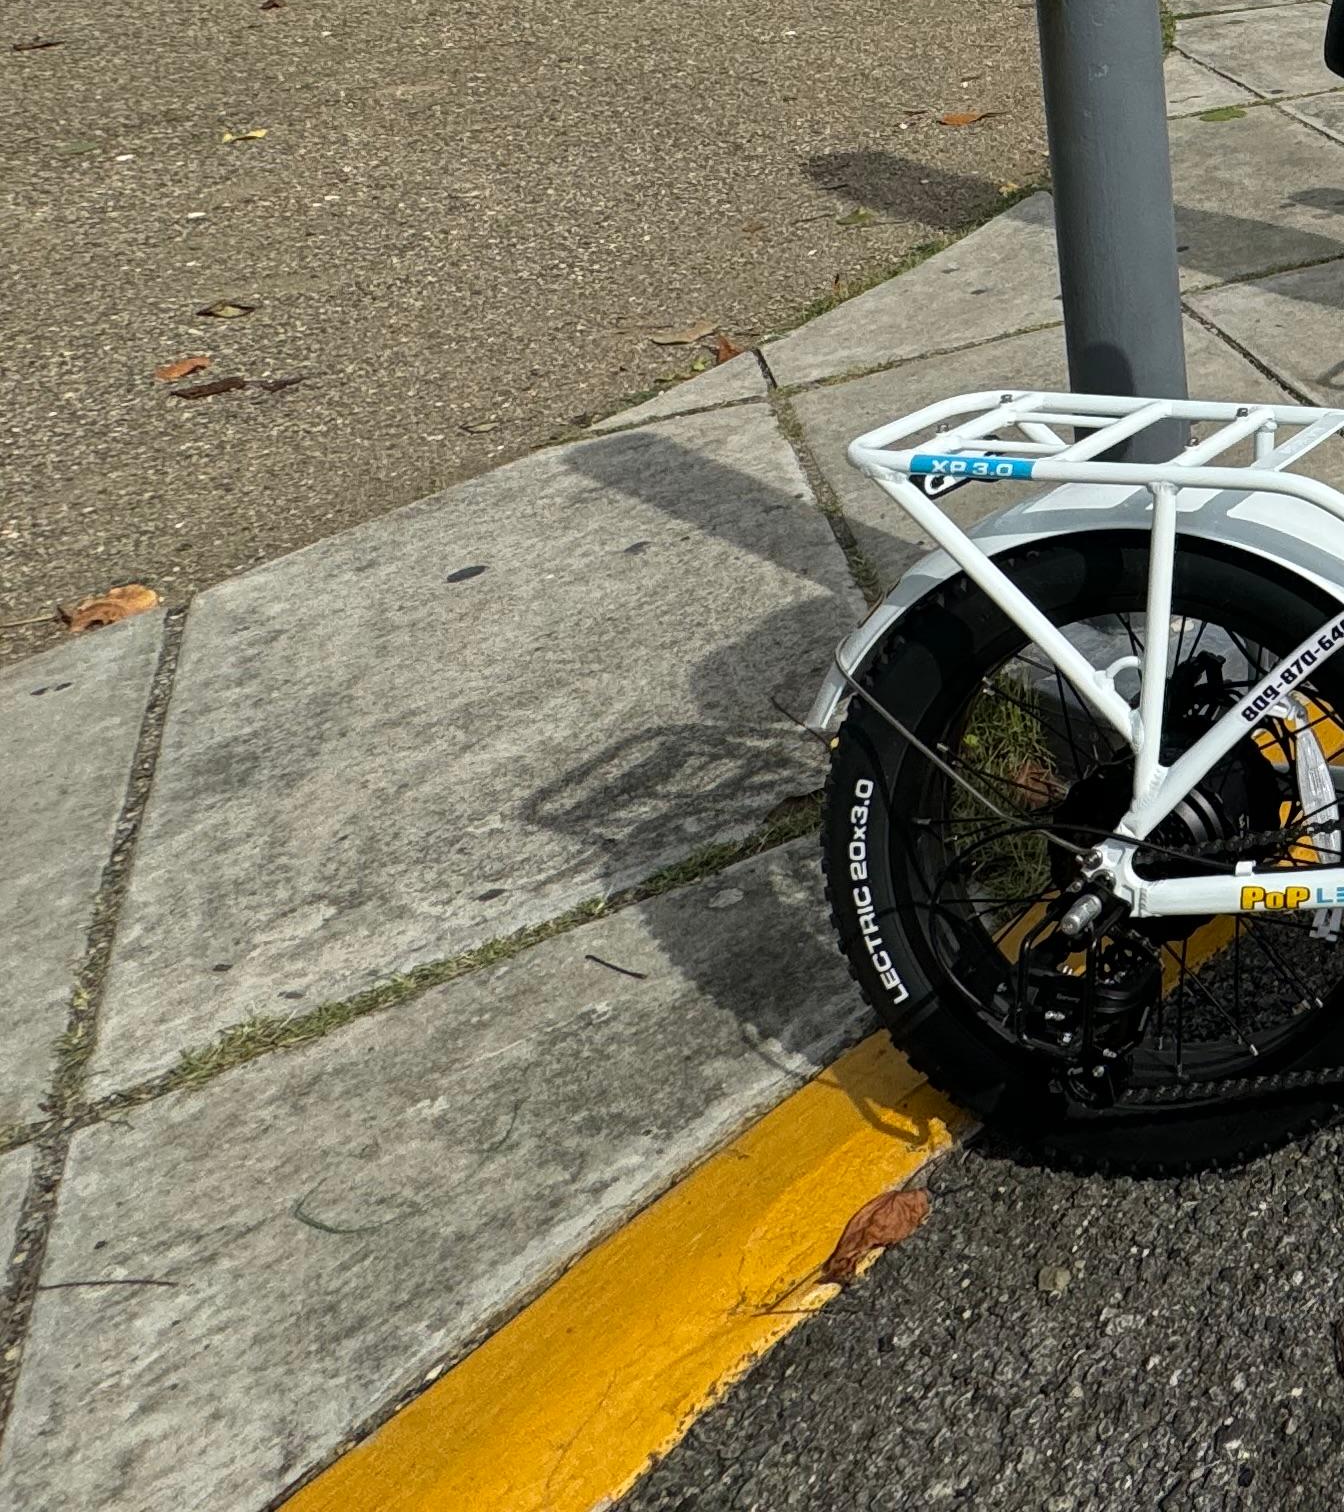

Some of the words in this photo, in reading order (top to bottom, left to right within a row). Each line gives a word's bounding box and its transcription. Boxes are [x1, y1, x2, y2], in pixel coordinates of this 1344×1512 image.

[931, 459, 967, 474] XP
[972, 462, 1014, 476] 3.0
[849, 778, 875, 881] 20x3.0
[1240, 885, 1310, 911] PoP
[852, 885, 909, 1005] LECTRIC
